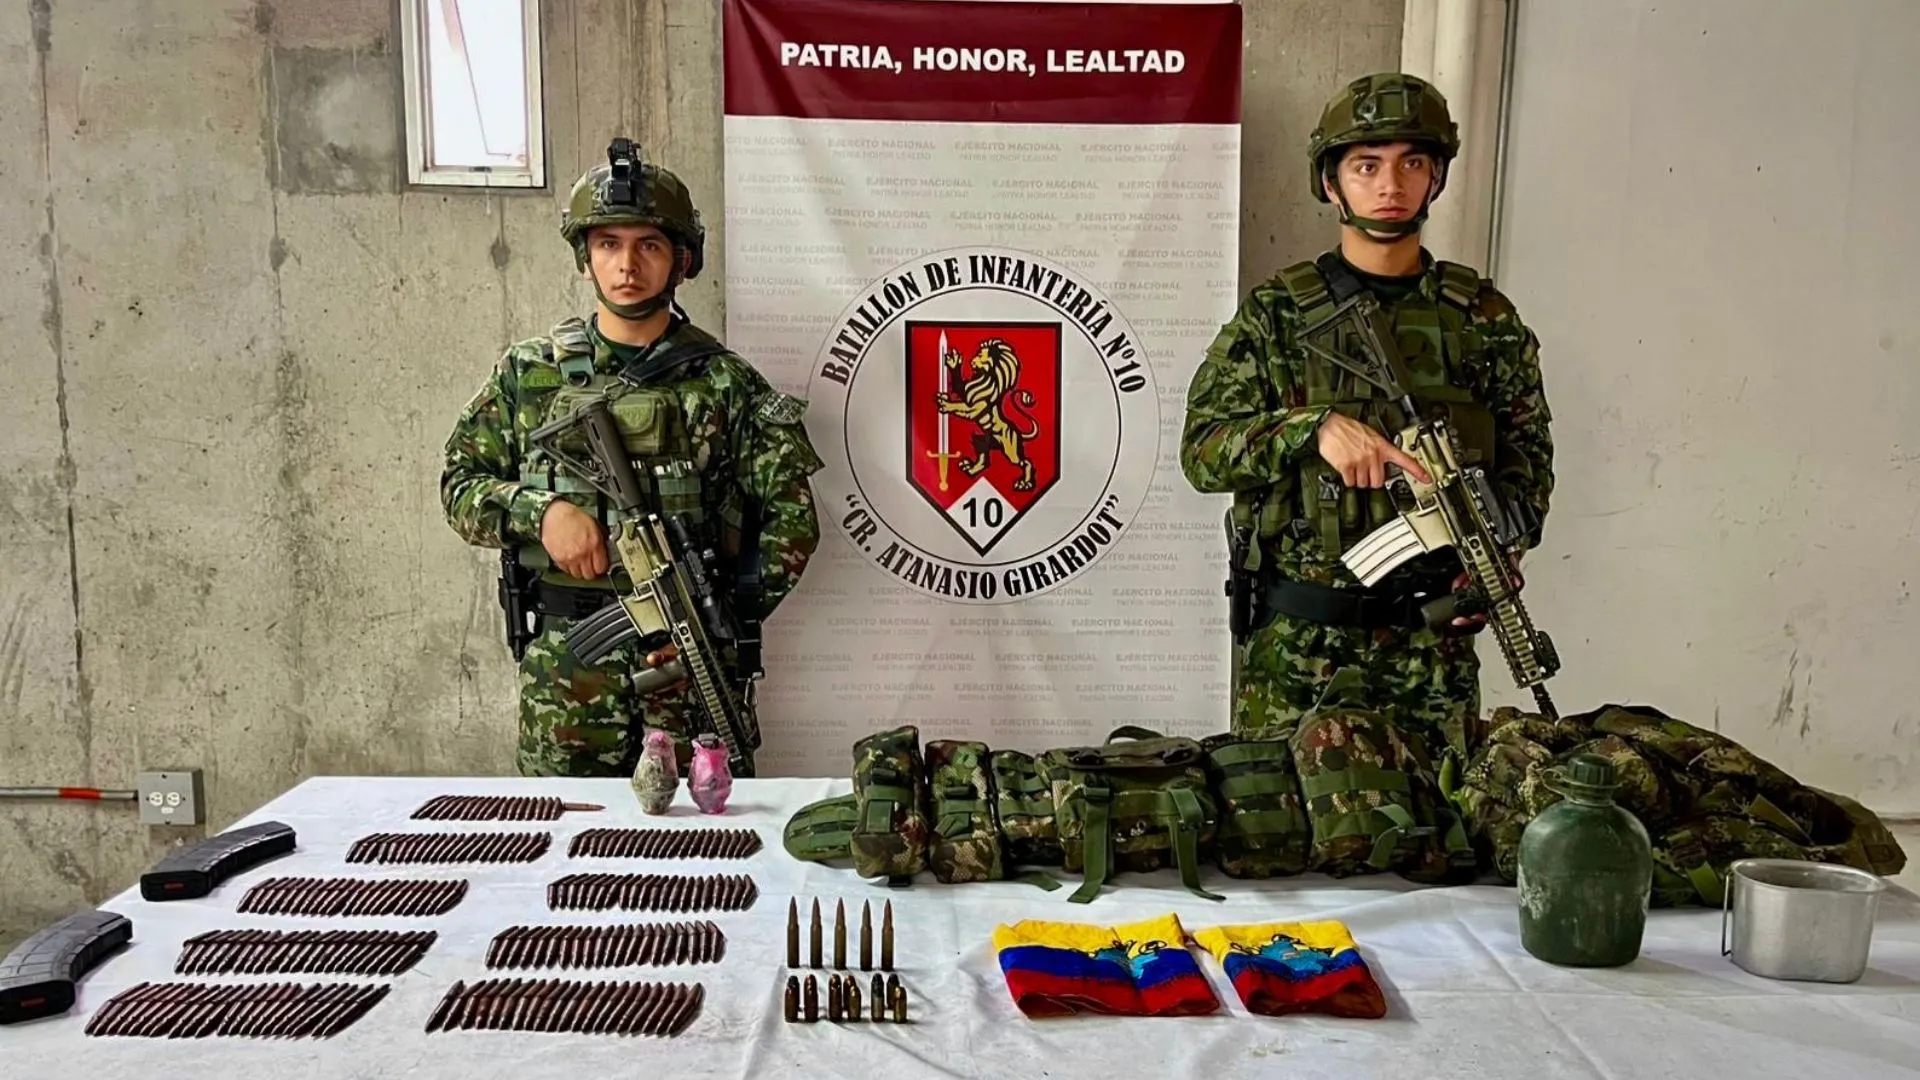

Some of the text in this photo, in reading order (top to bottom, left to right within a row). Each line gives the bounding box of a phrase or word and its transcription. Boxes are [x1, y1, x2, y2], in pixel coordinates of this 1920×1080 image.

[780, 42, 1185, 76] PATRIA, HONOR, LEALTAD
[820, 271, 922, 387] BATALLÓN
[923, 257, 962, 292] DE
[969, 255, 1114, 339] INFANTERÍA
[963, 497, 1003, 528] 10
[875, 541, 997, 600] ATANASIO
